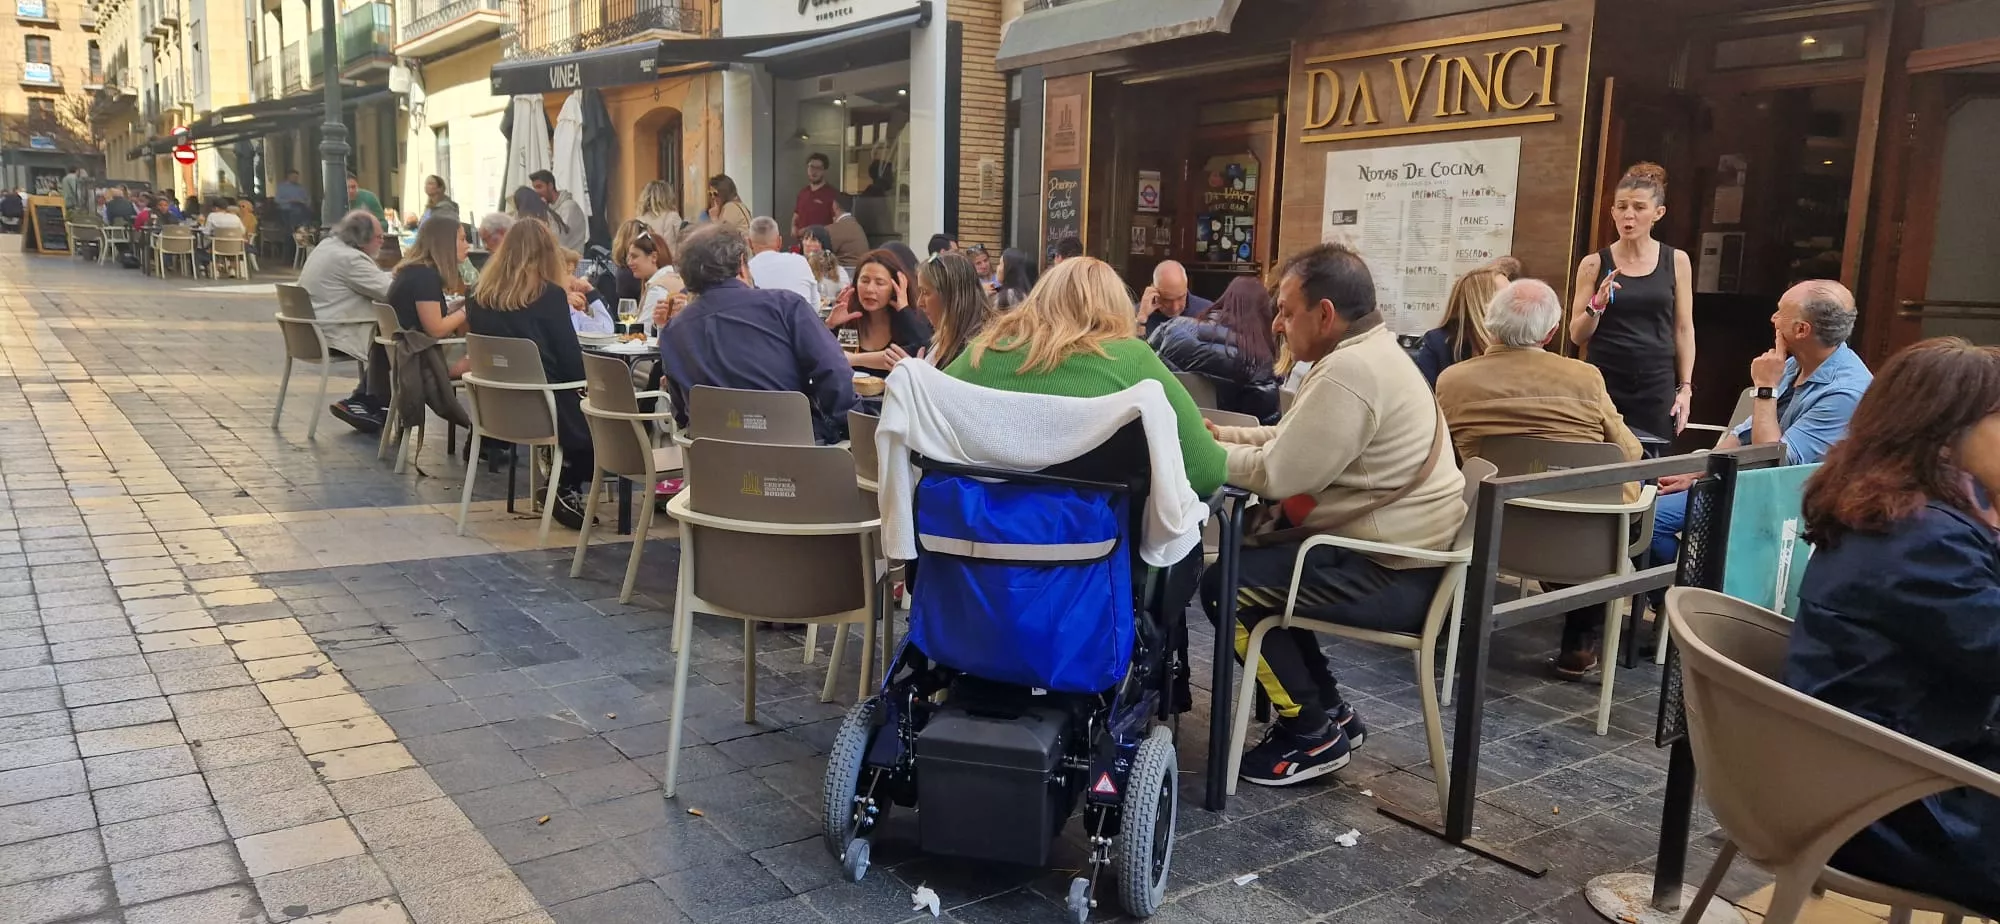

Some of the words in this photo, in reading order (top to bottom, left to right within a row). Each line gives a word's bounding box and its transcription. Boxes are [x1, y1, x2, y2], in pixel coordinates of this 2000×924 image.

[550, 62, 581, 89] VINEA
[1303, 66, 1380, 130] DA
[1388, 43, 1561, 123] VINCI
[1460, 215, 1489, 225] CARNES
[1456, 248, 1493, 258] PESCADOS
[1403, 302, 1440, 312] TOSTADAS
